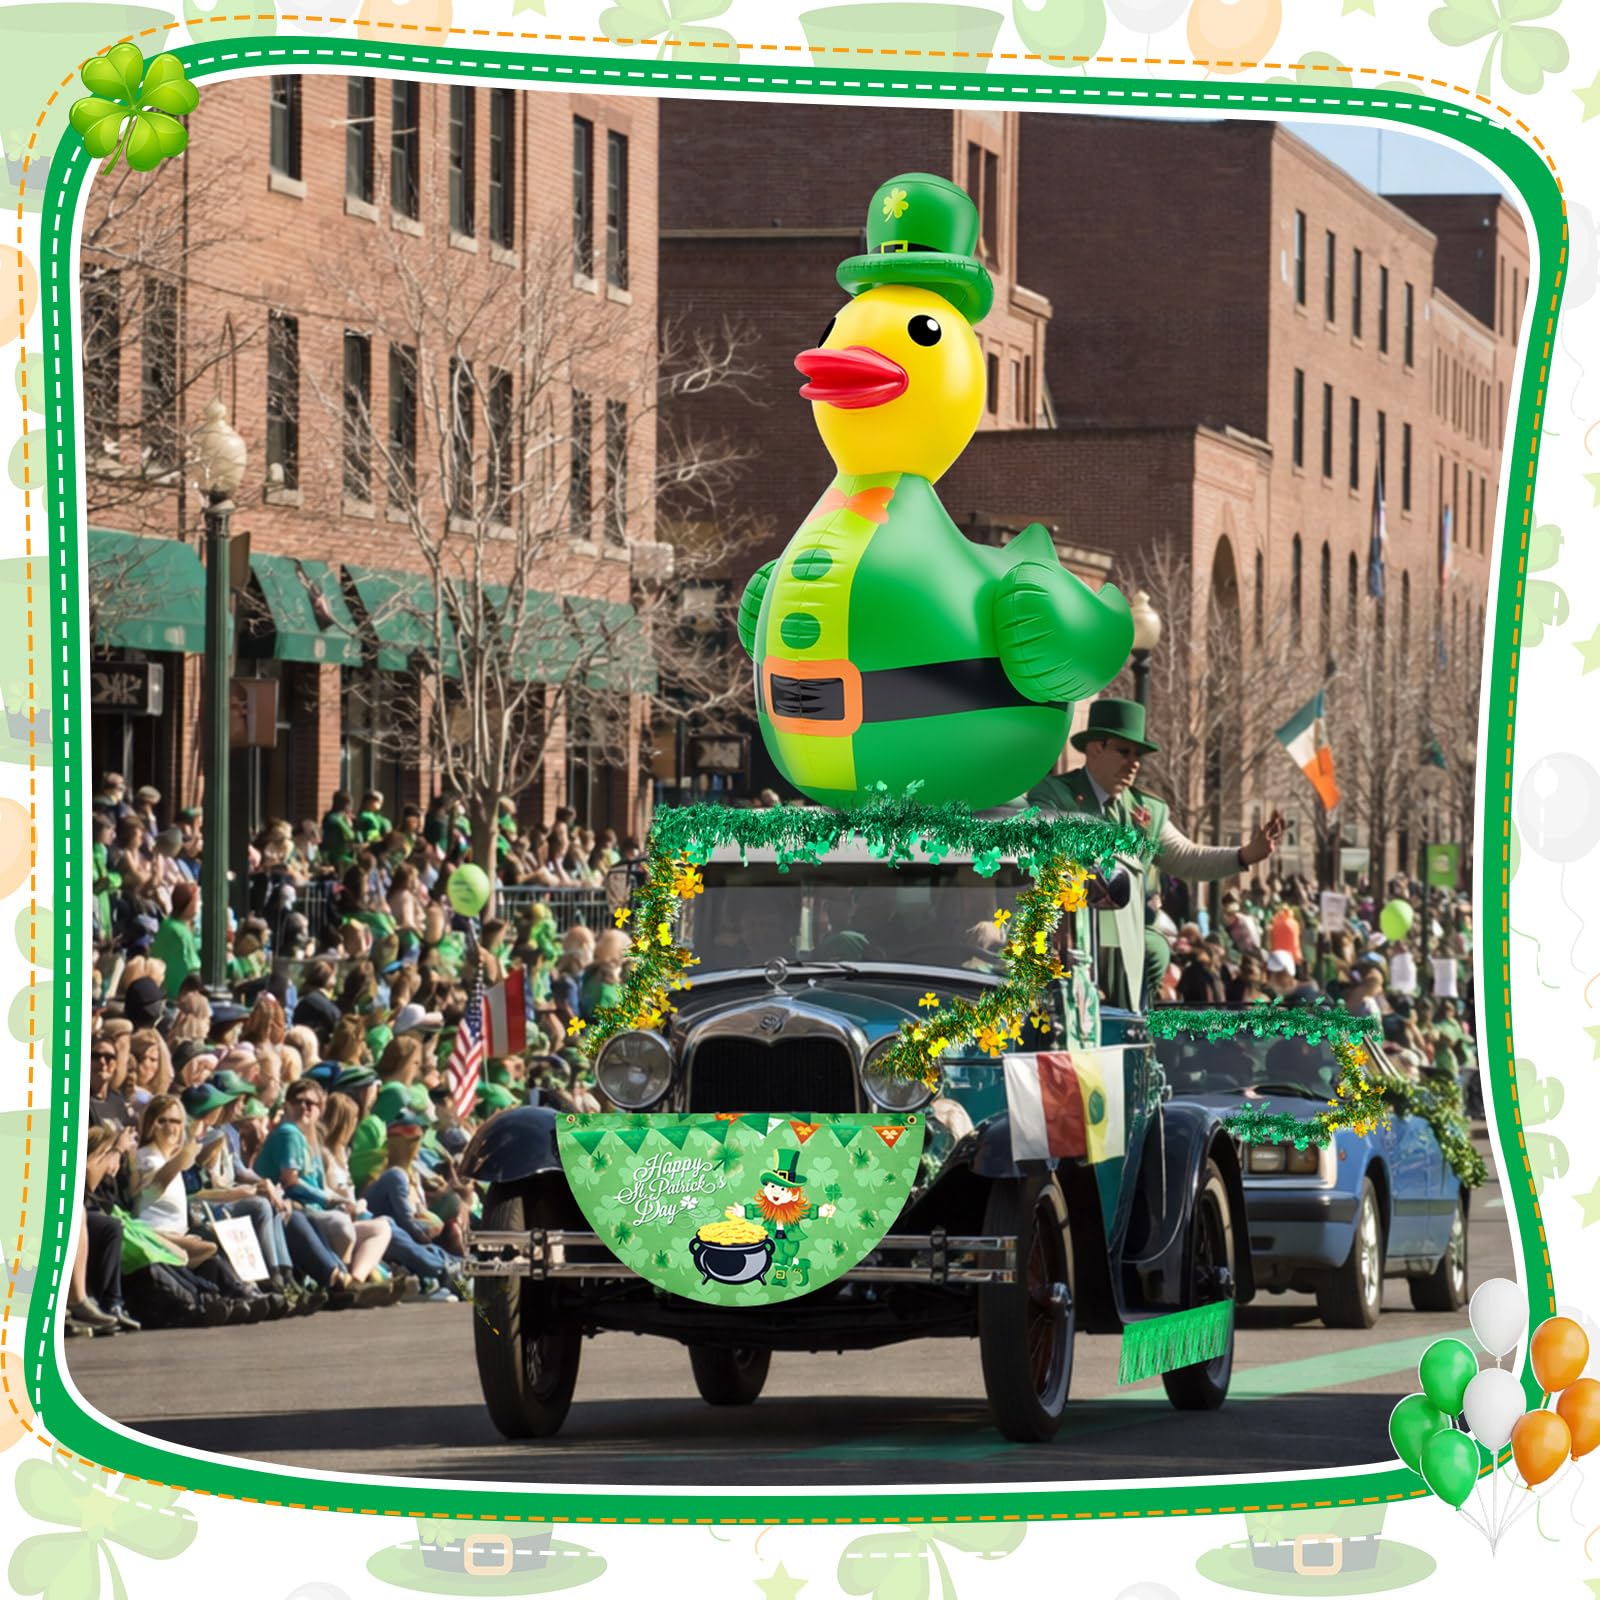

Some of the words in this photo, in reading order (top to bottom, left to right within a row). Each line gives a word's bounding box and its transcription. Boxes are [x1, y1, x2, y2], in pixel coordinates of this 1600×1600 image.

[633, 1152, 713, 1182] Happy
[648, 1174, 727, 1201] Patrick's
[633, 1196, 680, 1226] Day
